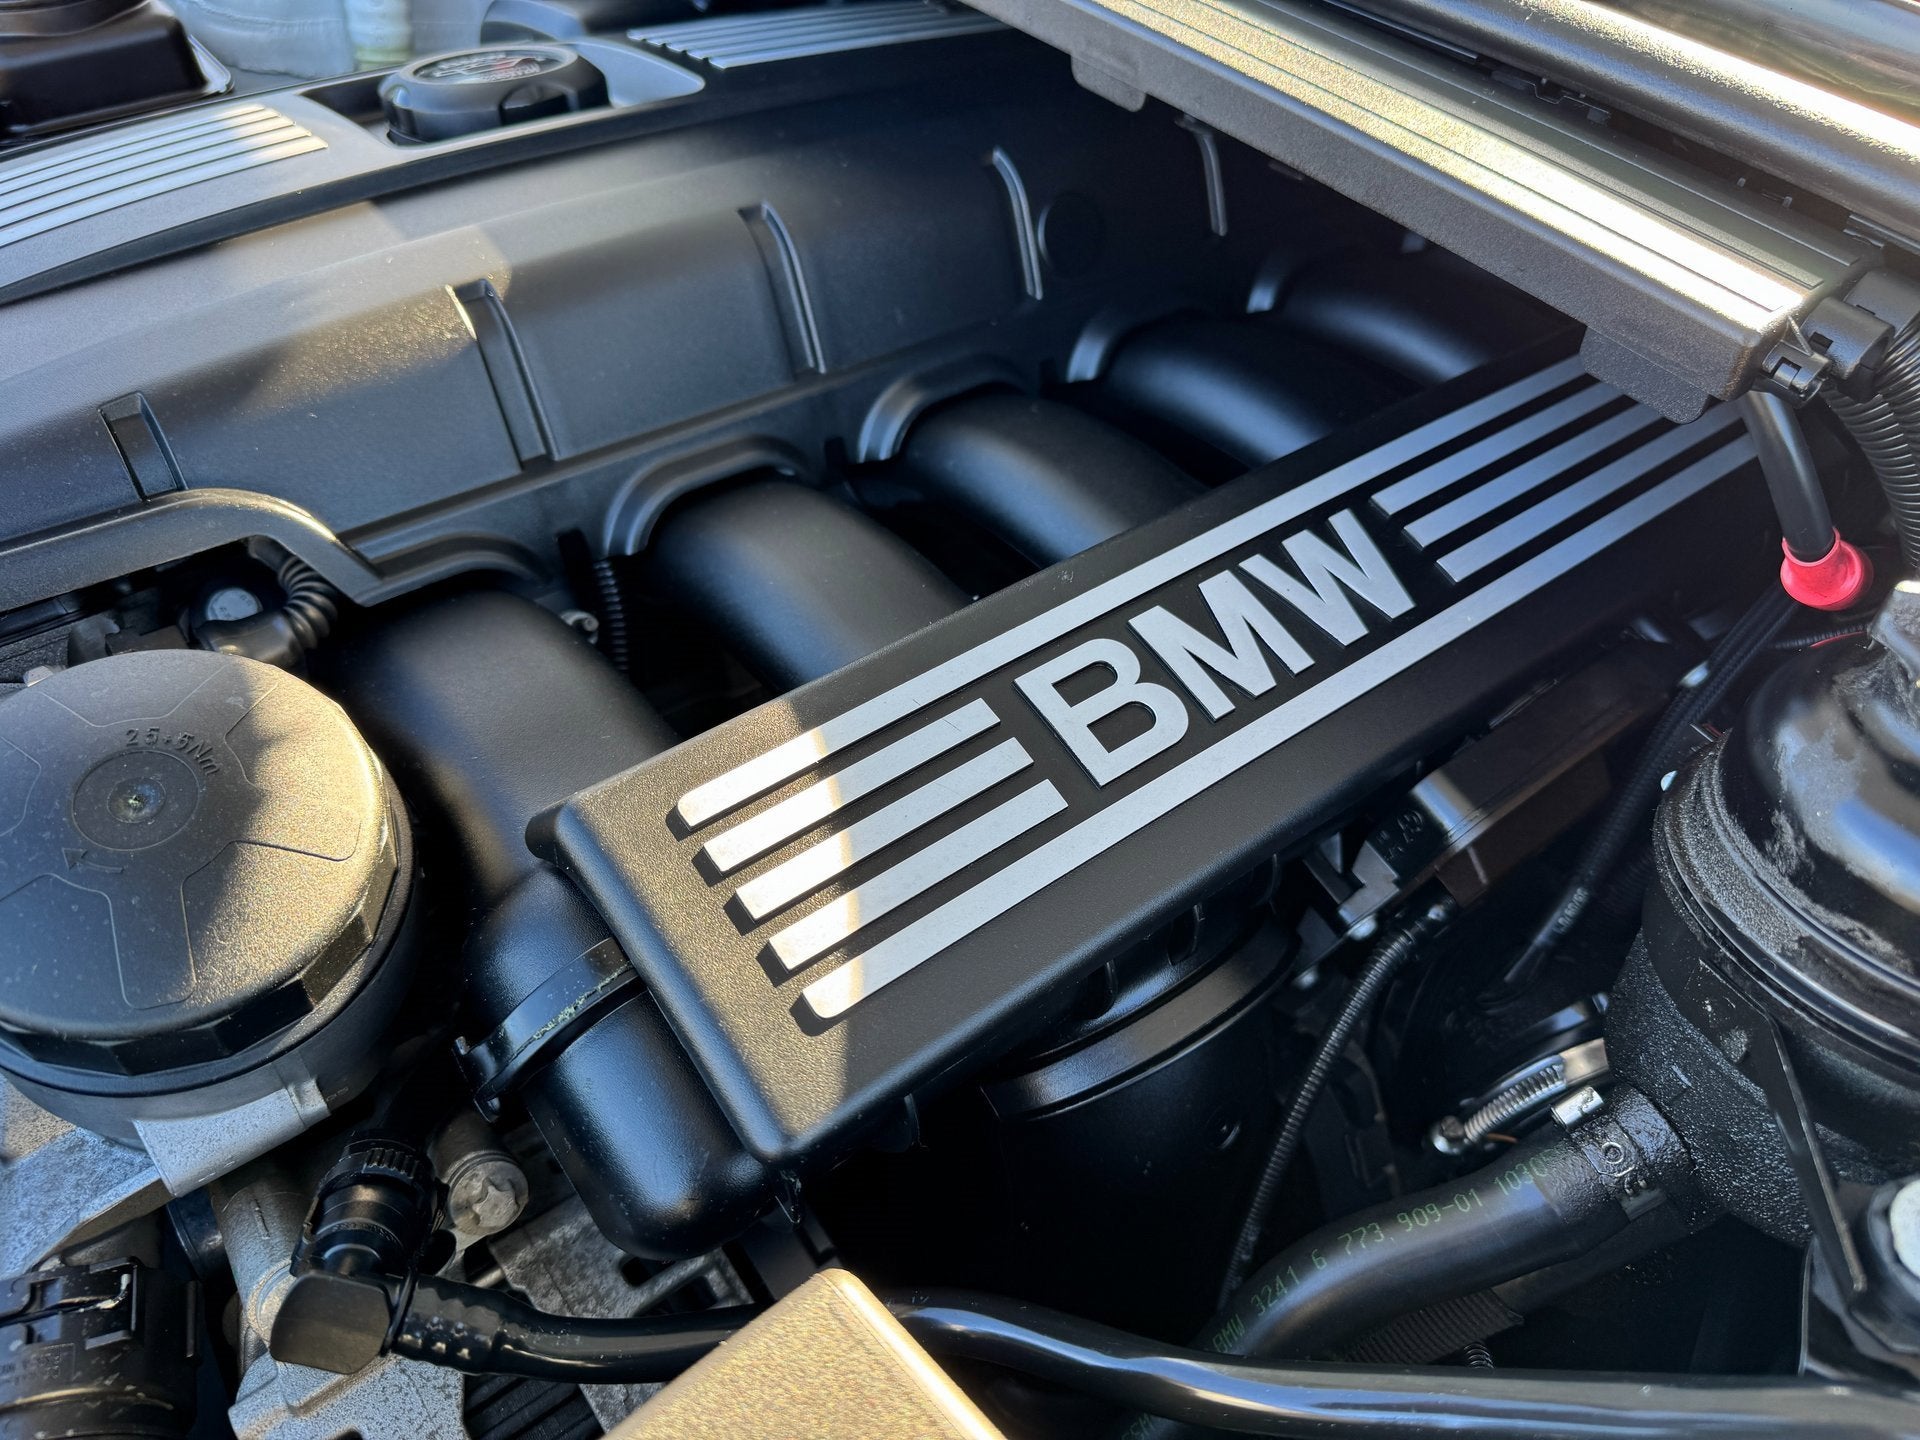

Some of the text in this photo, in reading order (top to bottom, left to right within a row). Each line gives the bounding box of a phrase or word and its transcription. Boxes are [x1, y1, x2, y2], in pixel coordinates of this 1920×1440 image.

[1013, 508, 1416, 788] BMW
[1212, 1313, 1246, 1353] BMW
[1251, 1265, 1300, 1317] 3241
[1311, 1249, 1328, 1271] 6
